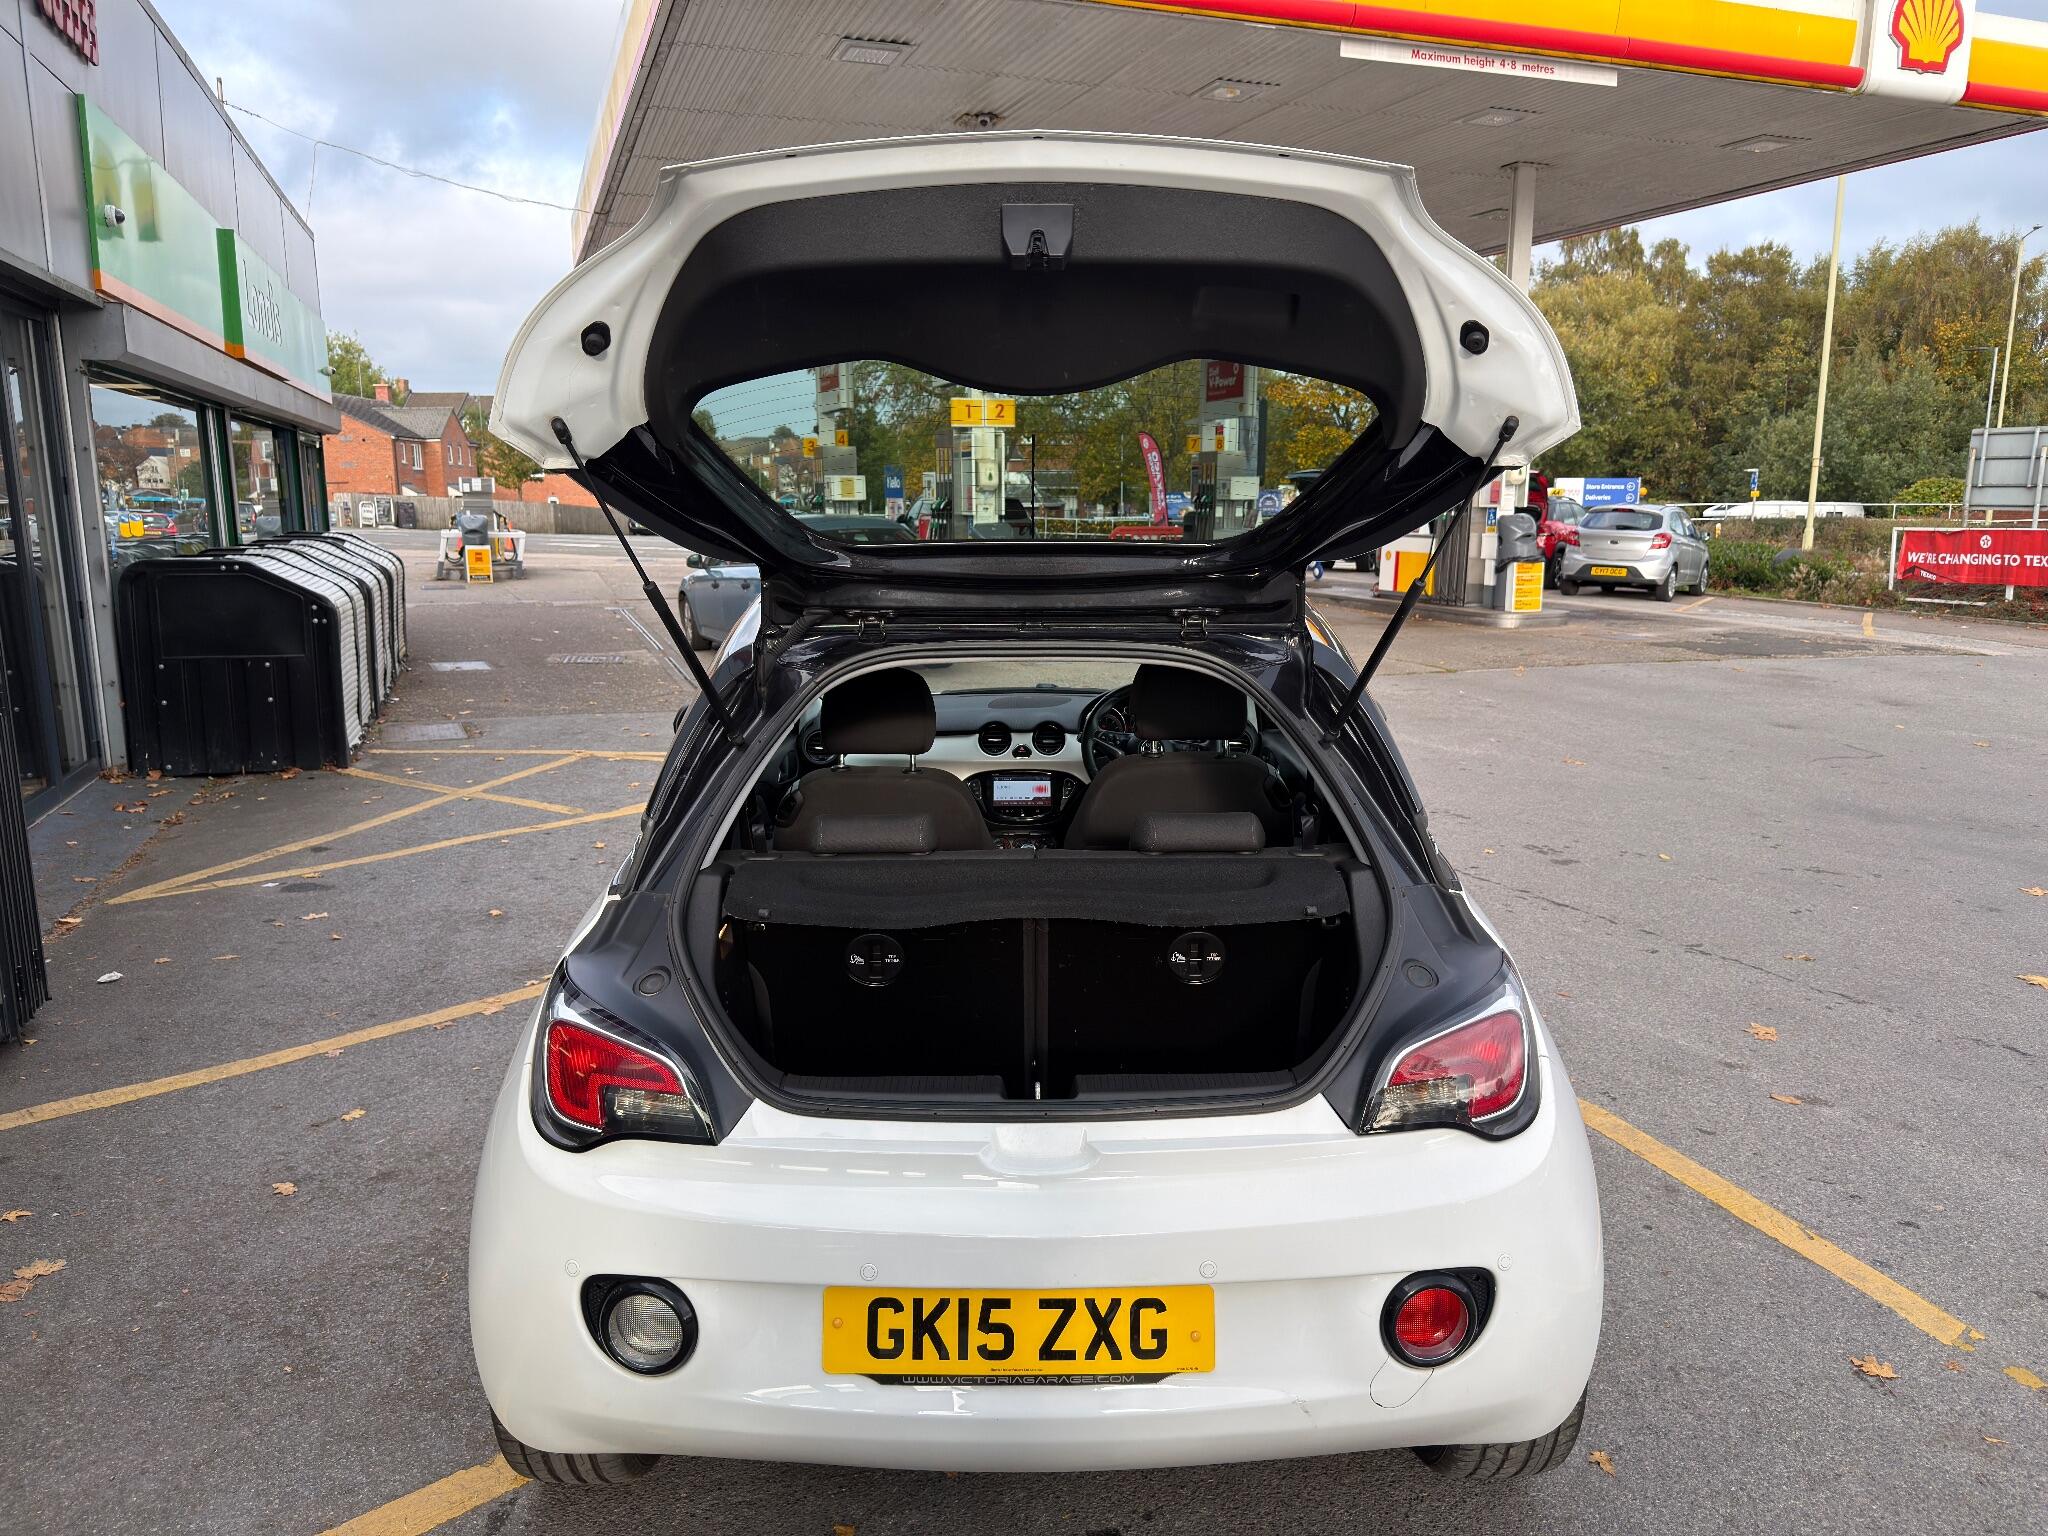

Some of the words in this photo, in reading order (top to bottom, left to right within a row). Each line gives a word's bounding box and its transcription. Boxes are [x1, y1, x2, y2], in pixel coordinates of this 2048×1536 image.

[1411, 49, 1461, 65] Maximum
[1463, 54, 1495, 69] height
[1521, 63, 1555, 75] metres
[966, 404, 971, 418] 1
[995, 403, 1004, 418] 2
[807, 440, 815, 451] 3
[838, 434, 845, 444] 4
[1190, 439, 1197, 448] 7
[1216, 439, 1222, 449] 8
[1907, 551, 1937, 564] WE'RE
[1938, 553, 2001, 566] CHANGING
[2003, 554, 2020, 566] TO
[866, 1296, 1015, 1361] GK15
[1038, 1296, 1168, 1361] ZXG
